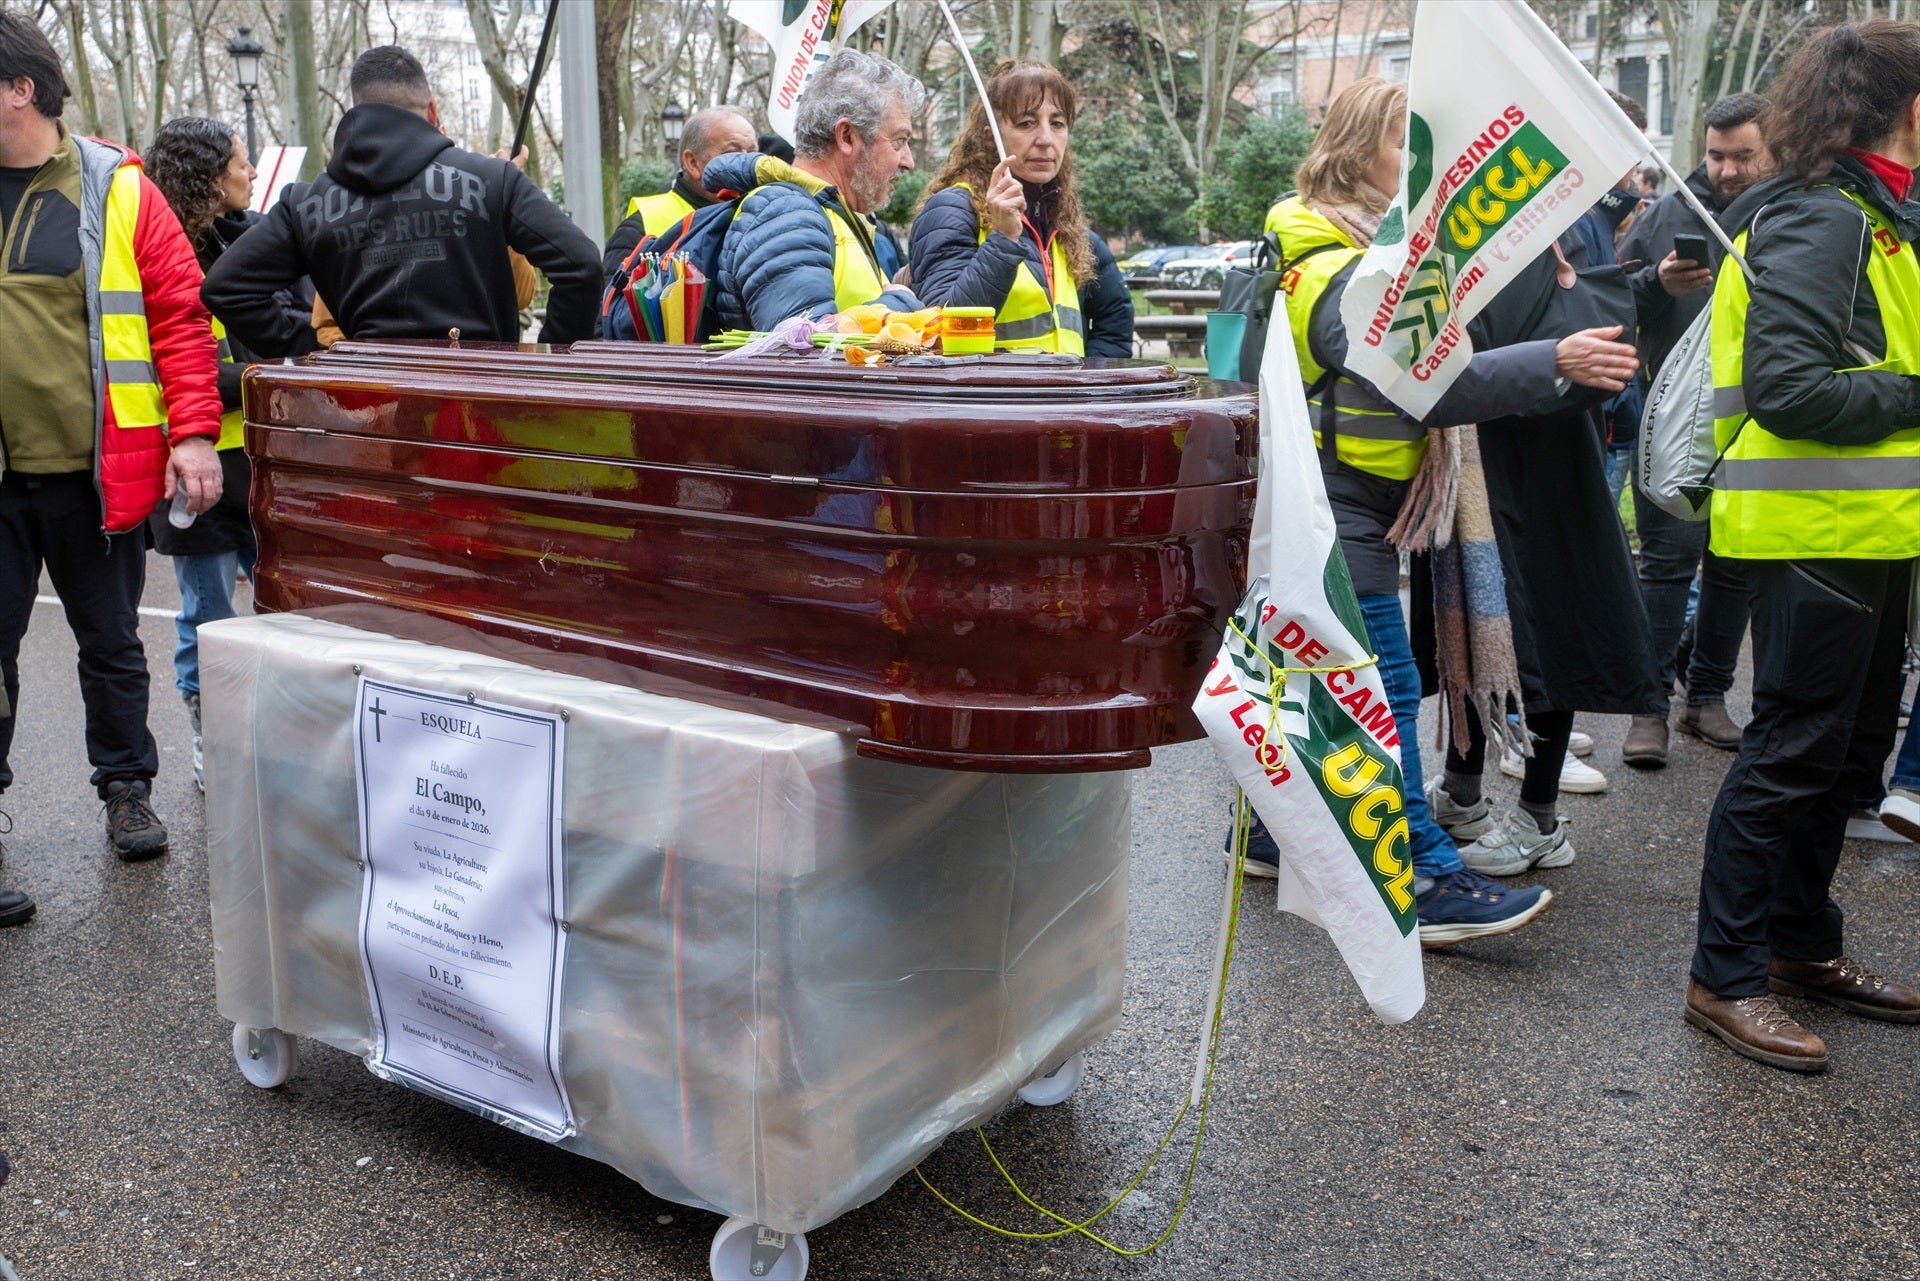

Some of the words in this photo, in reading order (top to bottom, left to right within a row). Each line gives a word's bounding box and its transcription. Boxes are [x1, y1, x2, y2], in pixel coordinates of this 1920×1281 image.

[777, 52, 809, 110] UNION
[801, 28, 818, 56] DE
[296, 163, 490, 243] BOUR
[1446, 146, 1554, 250] UCCL
[333, 218, 386, 251] DES
[394, 210, 468, 241] RUES
[1273, 620, 1329, 669] DE
[420, 712, 482, 740] ESQUELA
[1204, 674, 1239, 697] y
[1229, 698, 1291, 787] León
[430, 760, 439, 772] Ha
[440, 762, 468, 780] fallecido
[415, 777, 429, 798] El
[433, 783, 486, 816] Campo,
[409, 805, 415, 814] el
[426, 810, 431, 819] 9
[432, 811, 440, 821] de
[442, 816, 461, 827] enero
[462, 819, 470, 829] de
[471, 821, 492, 836] 2026.
[1322, 741, 1415, 914] UCCL
[443, 849, 451, 860] La
[452, 852, 488, 875] Agricultura;
[445, 867, 452, 878] La
[393, 901, 435, 928] Aprovechamiento
[436, 919, 443, 930] de
[443, 922, 471, 941] Bosques
[471, 935, 477, 945] y
[479, 934, 504, 950] Heno,
[433, 899, 441, 911] La
[441, 903, 460, 920] Pesca,
[411, 931, 421, 940] con
[421, 935, 446, 950] profundo
[446, 942, 461, 955] dolor
[461, 950, 469, 958] su
[470, 949, 513, 969] fallecimiento.
[402, 1023, 431, 1041] Ministerio
[432, 1034, 438, 1043] de
[439, 1037, 472, 1059] Agricultura,
[472, 1050, 489, 1064] Pesca
[489, 1059, 494, 1068] y
